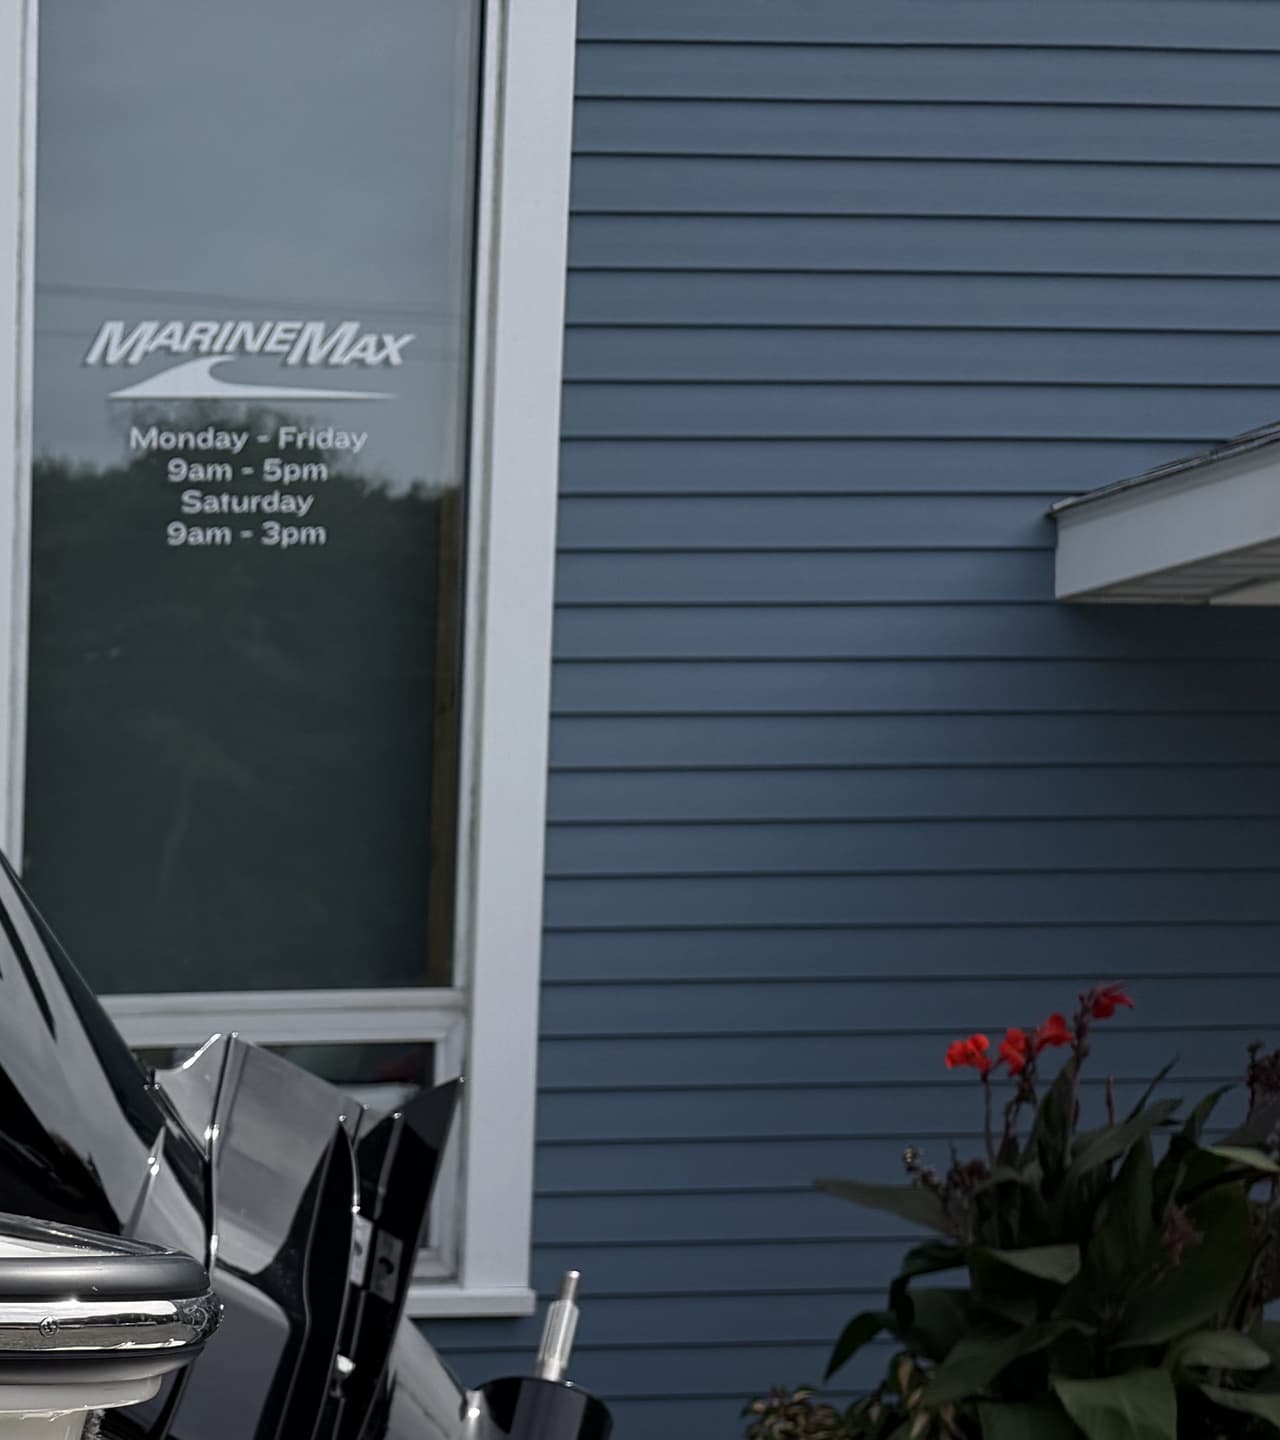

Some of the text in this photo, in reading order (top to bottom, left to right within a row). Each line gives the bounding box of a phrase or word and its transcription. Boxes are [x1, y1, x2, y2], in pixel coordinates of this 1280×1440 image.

[130, 427, 248, 454] Monday
[278, 427, 368, 454] Friday
[167, 458, 233, 482] 9am
[262, 458, 329, 486] 5pm
[181, 490, 314, 518] Saturday
[167, 521, 232, 546] 9am
[261, 521, 327, 549] 3pm
